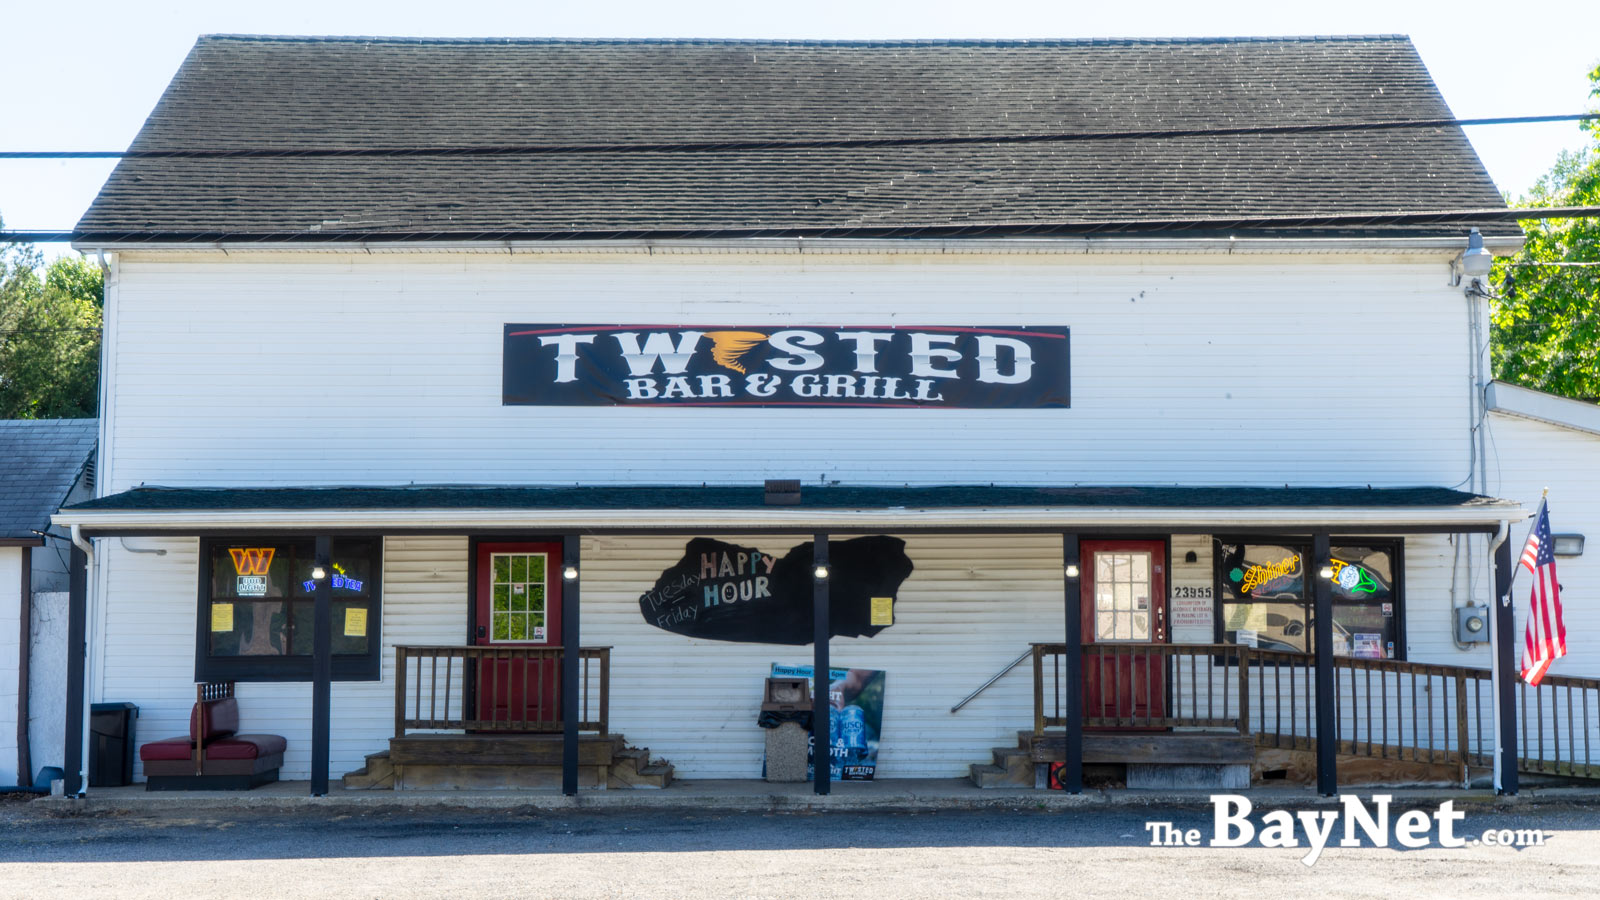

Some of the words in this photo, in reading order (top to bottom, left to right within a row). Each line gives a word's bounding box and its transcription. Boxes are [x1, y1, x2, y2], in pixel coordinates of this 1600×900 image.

[623, 374, 735, 399] BAR
[745, 373, 781, 397] &
[790, 374, 944, 401] GRILL
[701, 551, 777, 579] HAPPY
[1241, 555, 1300, 593] Shiner
[641, 573, 701, 612] Tuesday
[703, 577, 772, 608] HOUR
[1175, 587, 1212, 598] 23955
[656, 604, 699, 627] Friday
[775, 667, 796, 675] Happy
[796, 667, 812, 675] Hour
